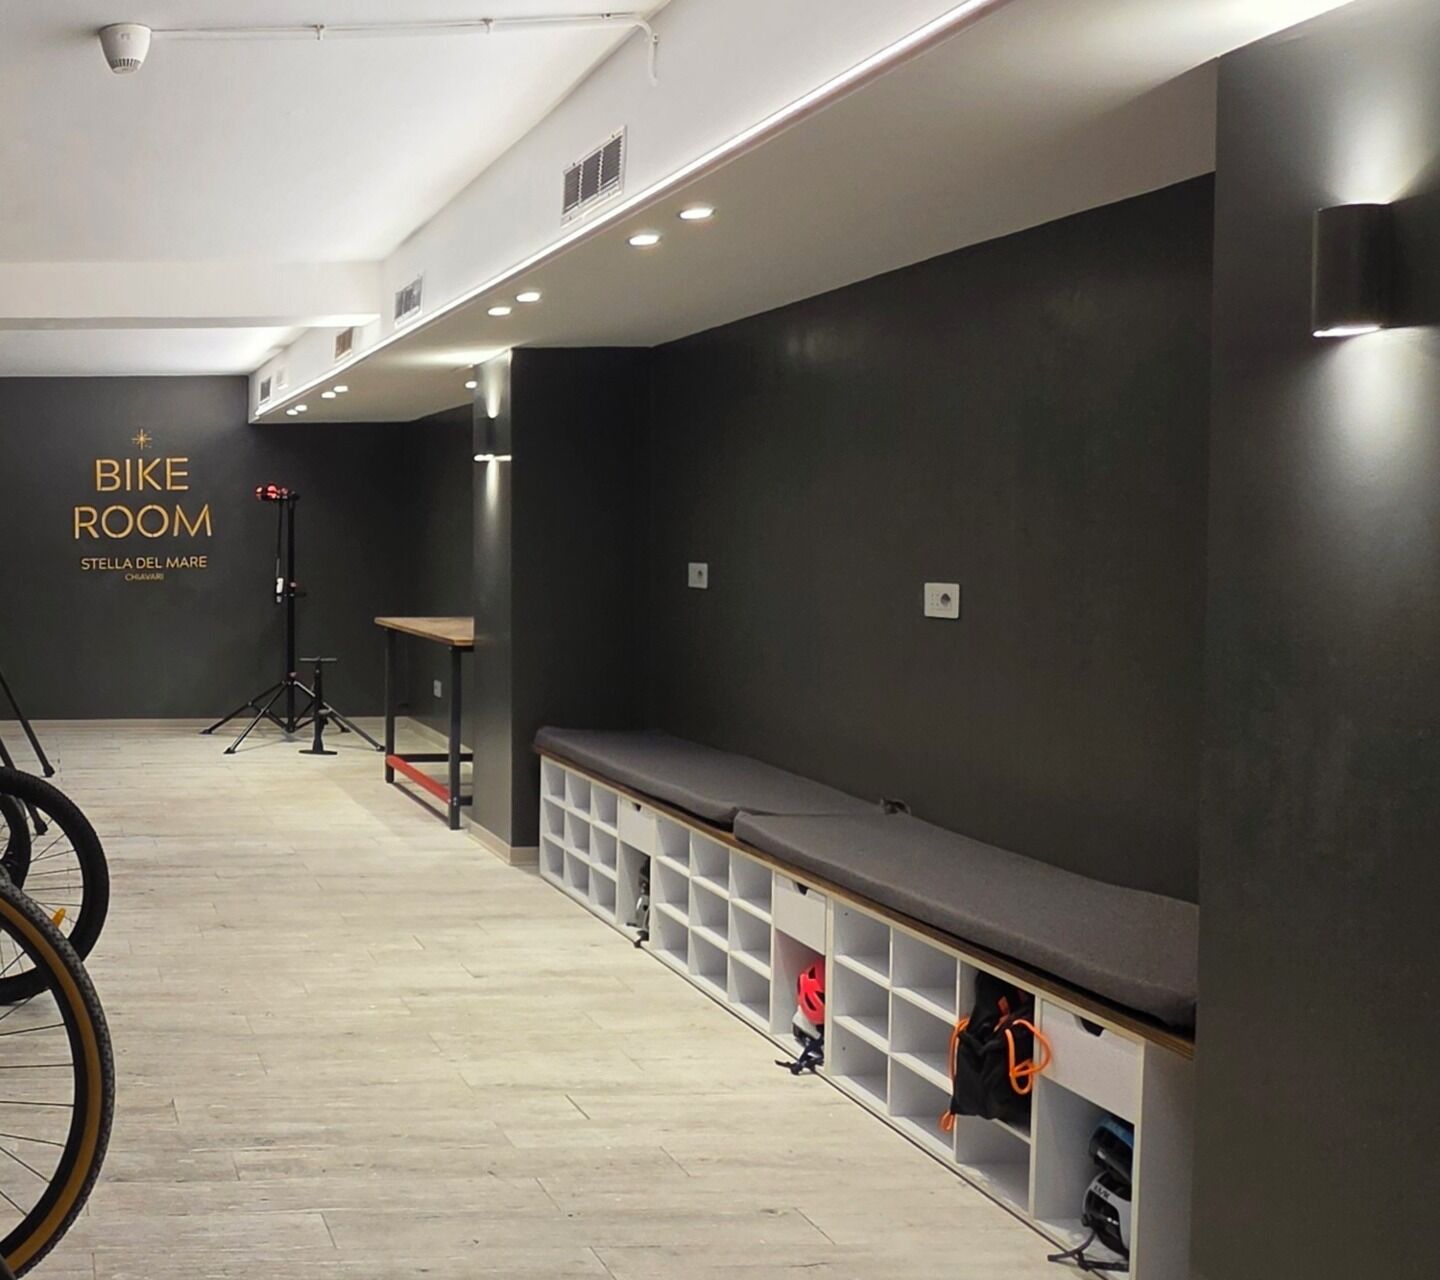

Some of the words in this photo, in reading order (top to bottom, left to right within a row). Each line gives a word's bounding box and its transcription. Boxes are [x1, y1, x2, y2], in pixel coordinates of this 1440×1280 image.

[95, 457, 190, 492] BIKE
[74, 503, 213, 539] ROOM
[80, 557, 133, 571] STELLA
[135, 557, 162, 570] DEL
[165, 556, 208, 569] MARE
